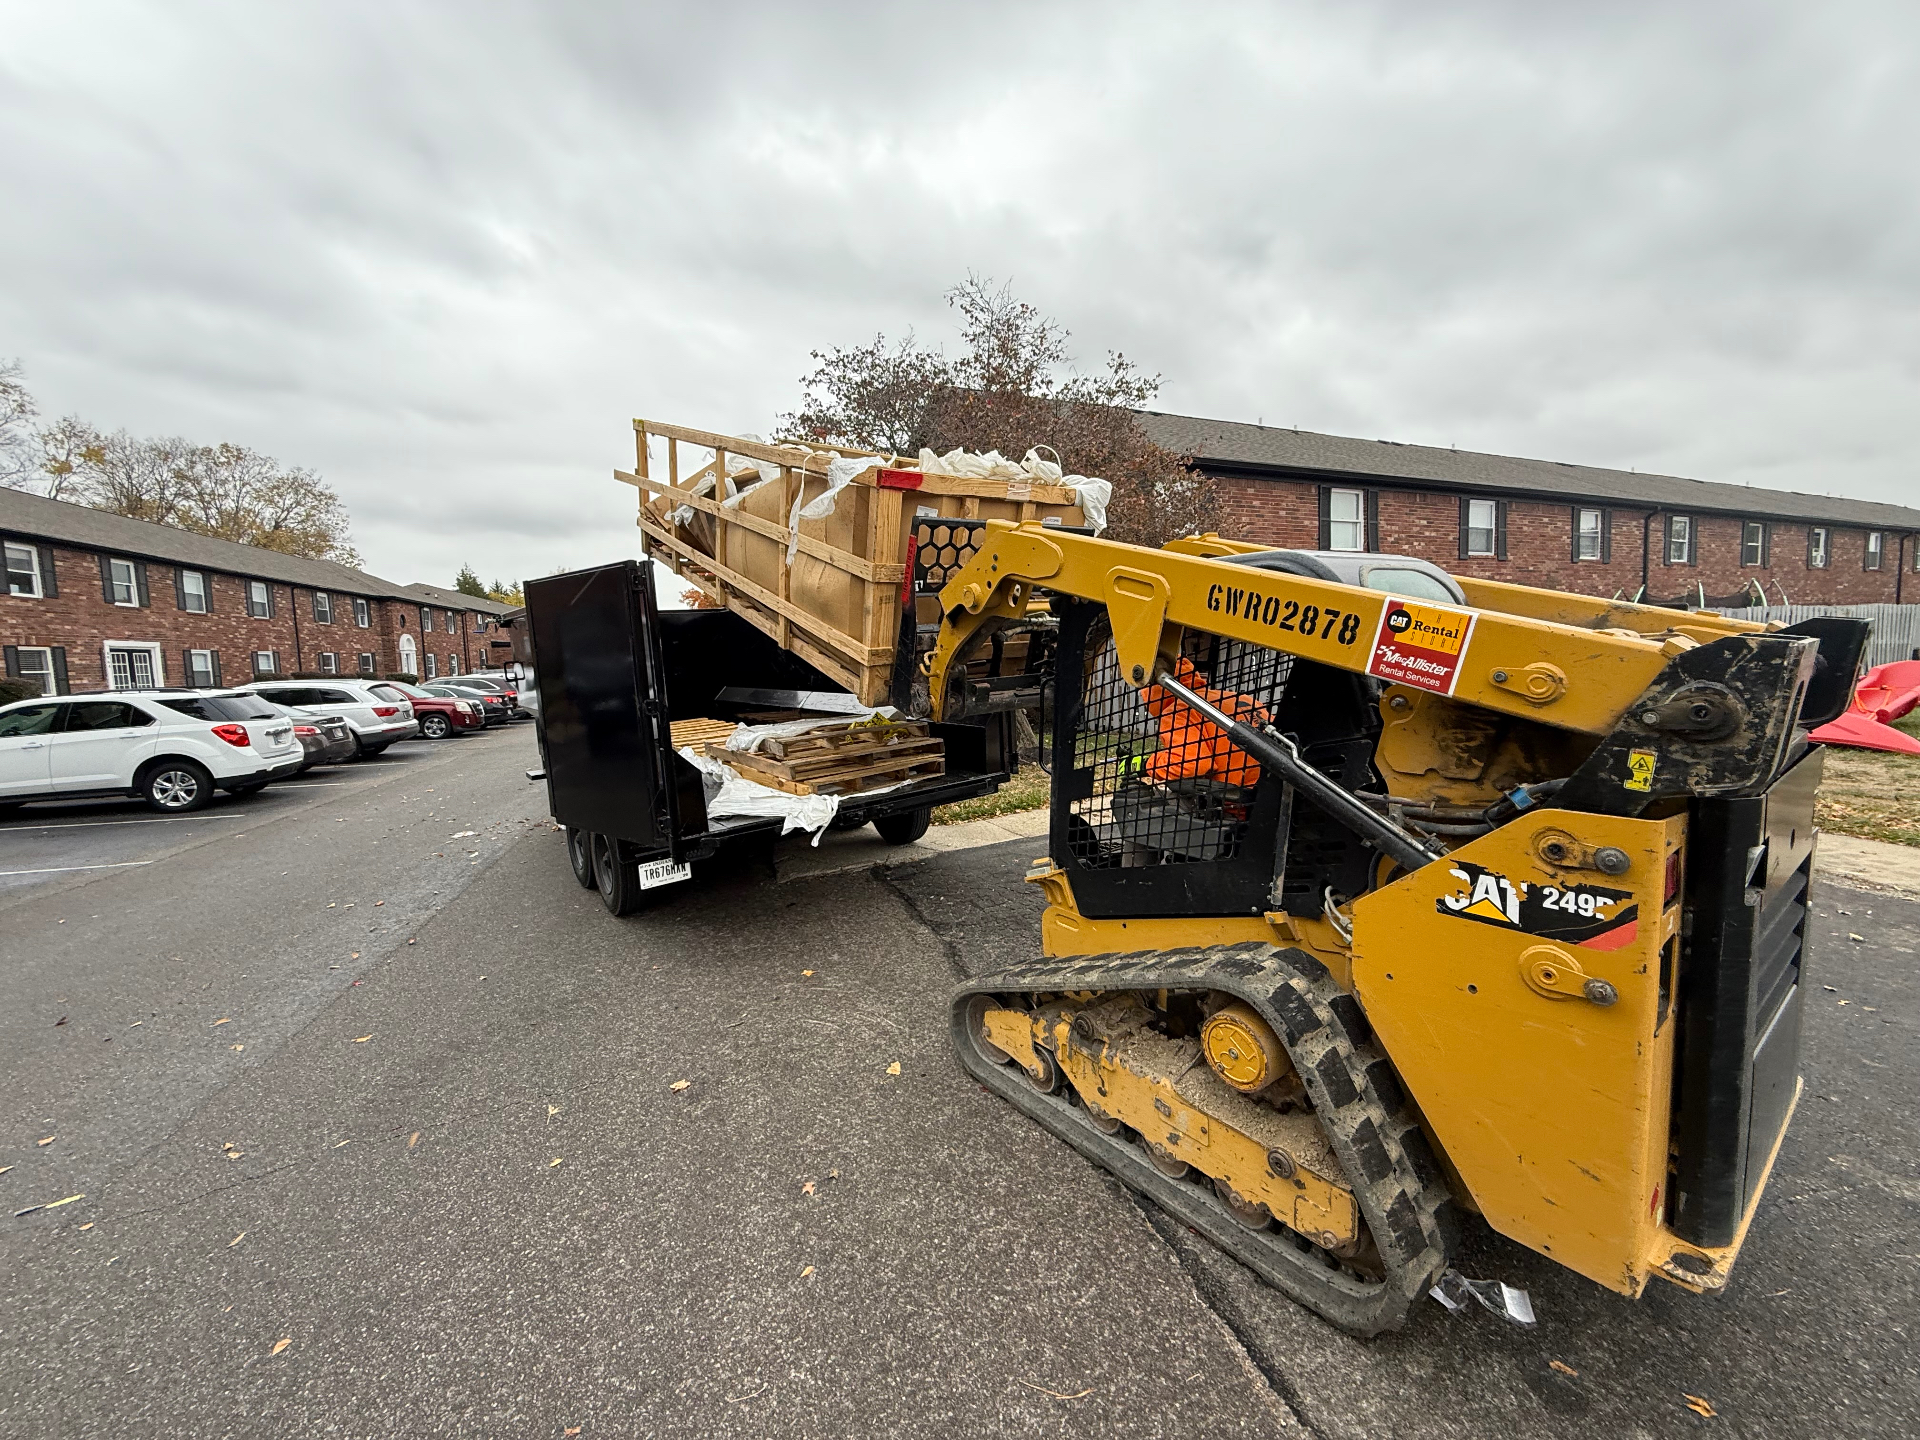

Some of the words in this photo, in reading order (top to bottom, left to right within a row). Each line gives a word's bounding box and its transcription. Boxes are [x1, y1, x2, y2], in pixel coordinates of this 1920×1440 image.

[1207, 583, 1361, 646] GWR02878
[1390, 615, 1408, 628] CAT
[1413, 620, 1459, 639] Rental
[1379, 664, 1404, 677] Rental
[1405, 670, 1441, 687] Services
[1382, 651, 1451, 676] MacAllister
